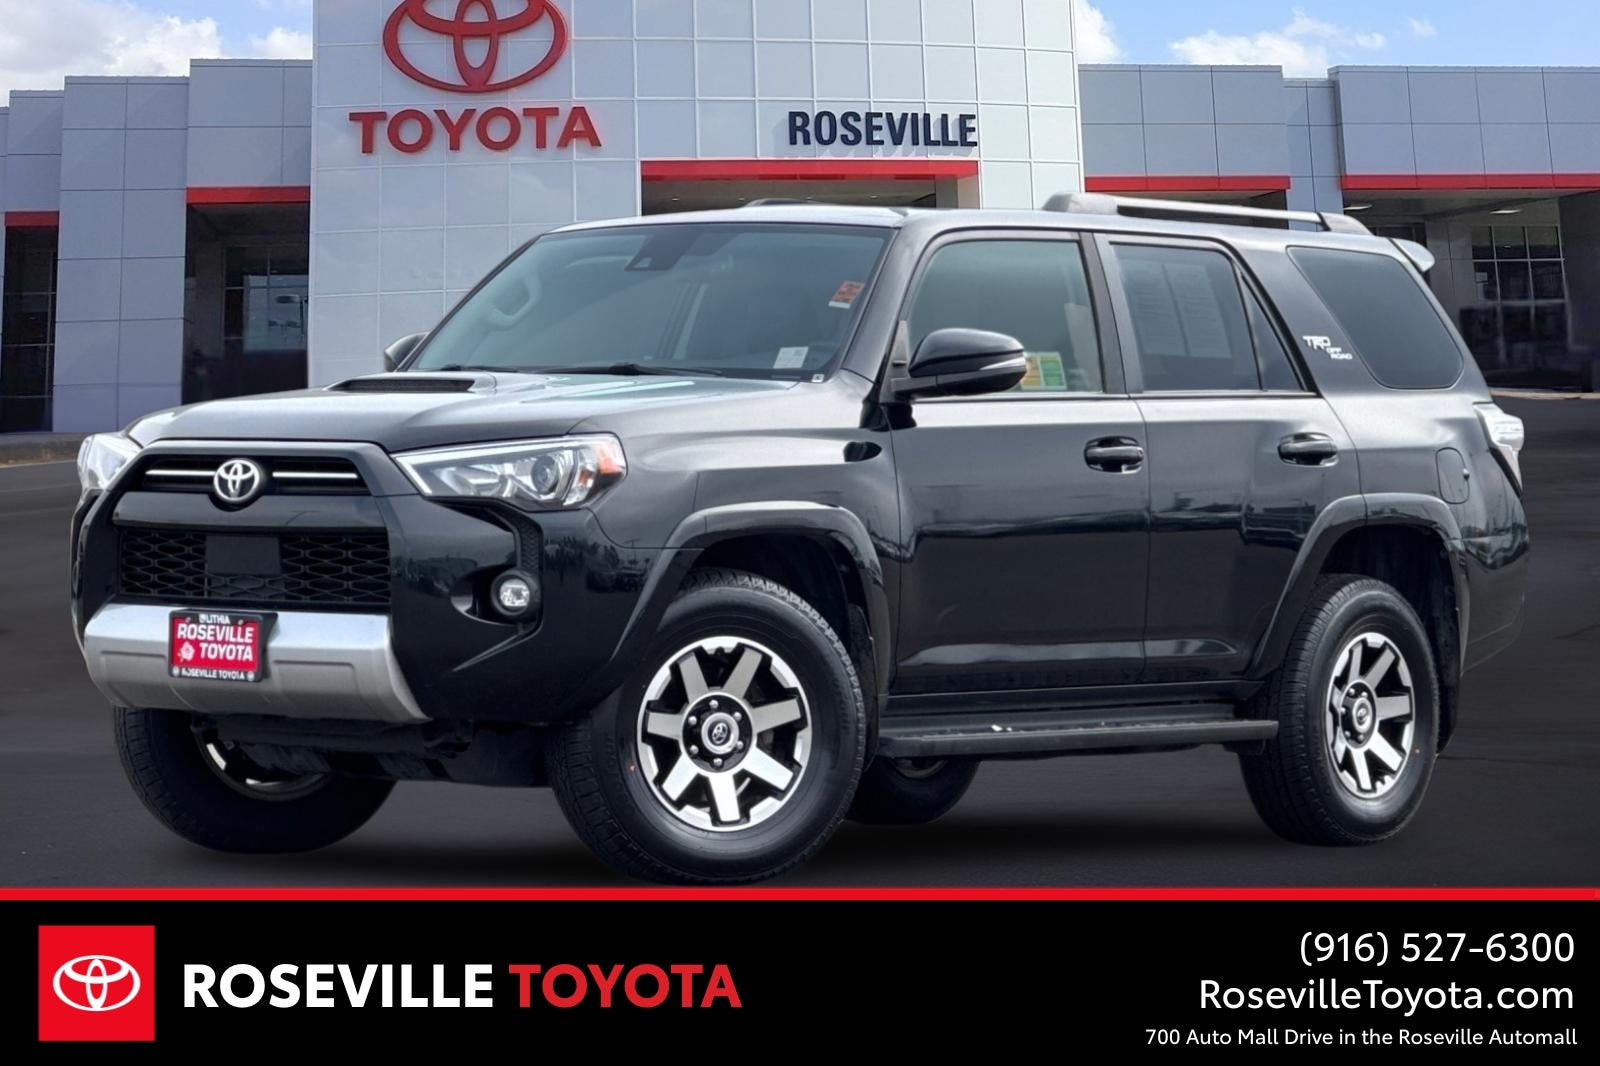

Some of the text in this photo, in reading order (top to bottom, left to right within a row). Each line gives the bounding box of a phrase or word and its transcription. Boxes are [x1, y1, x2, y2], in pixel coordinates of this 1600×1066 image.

[349, 105, 602, 154] TOYOTA
[788, 110, 978, 147] ROSEVILLE
[1302, 335, 1331, 350] TRD
[1330, 352, 1353, 360] ROAD
[205, 613, 231, 625] LITHIA
[177, 623, 255, 644] ROSEVILLE
[199, 642, 254, 662] TOYOTA
[218, 670, 246, 680] TOYOTA
